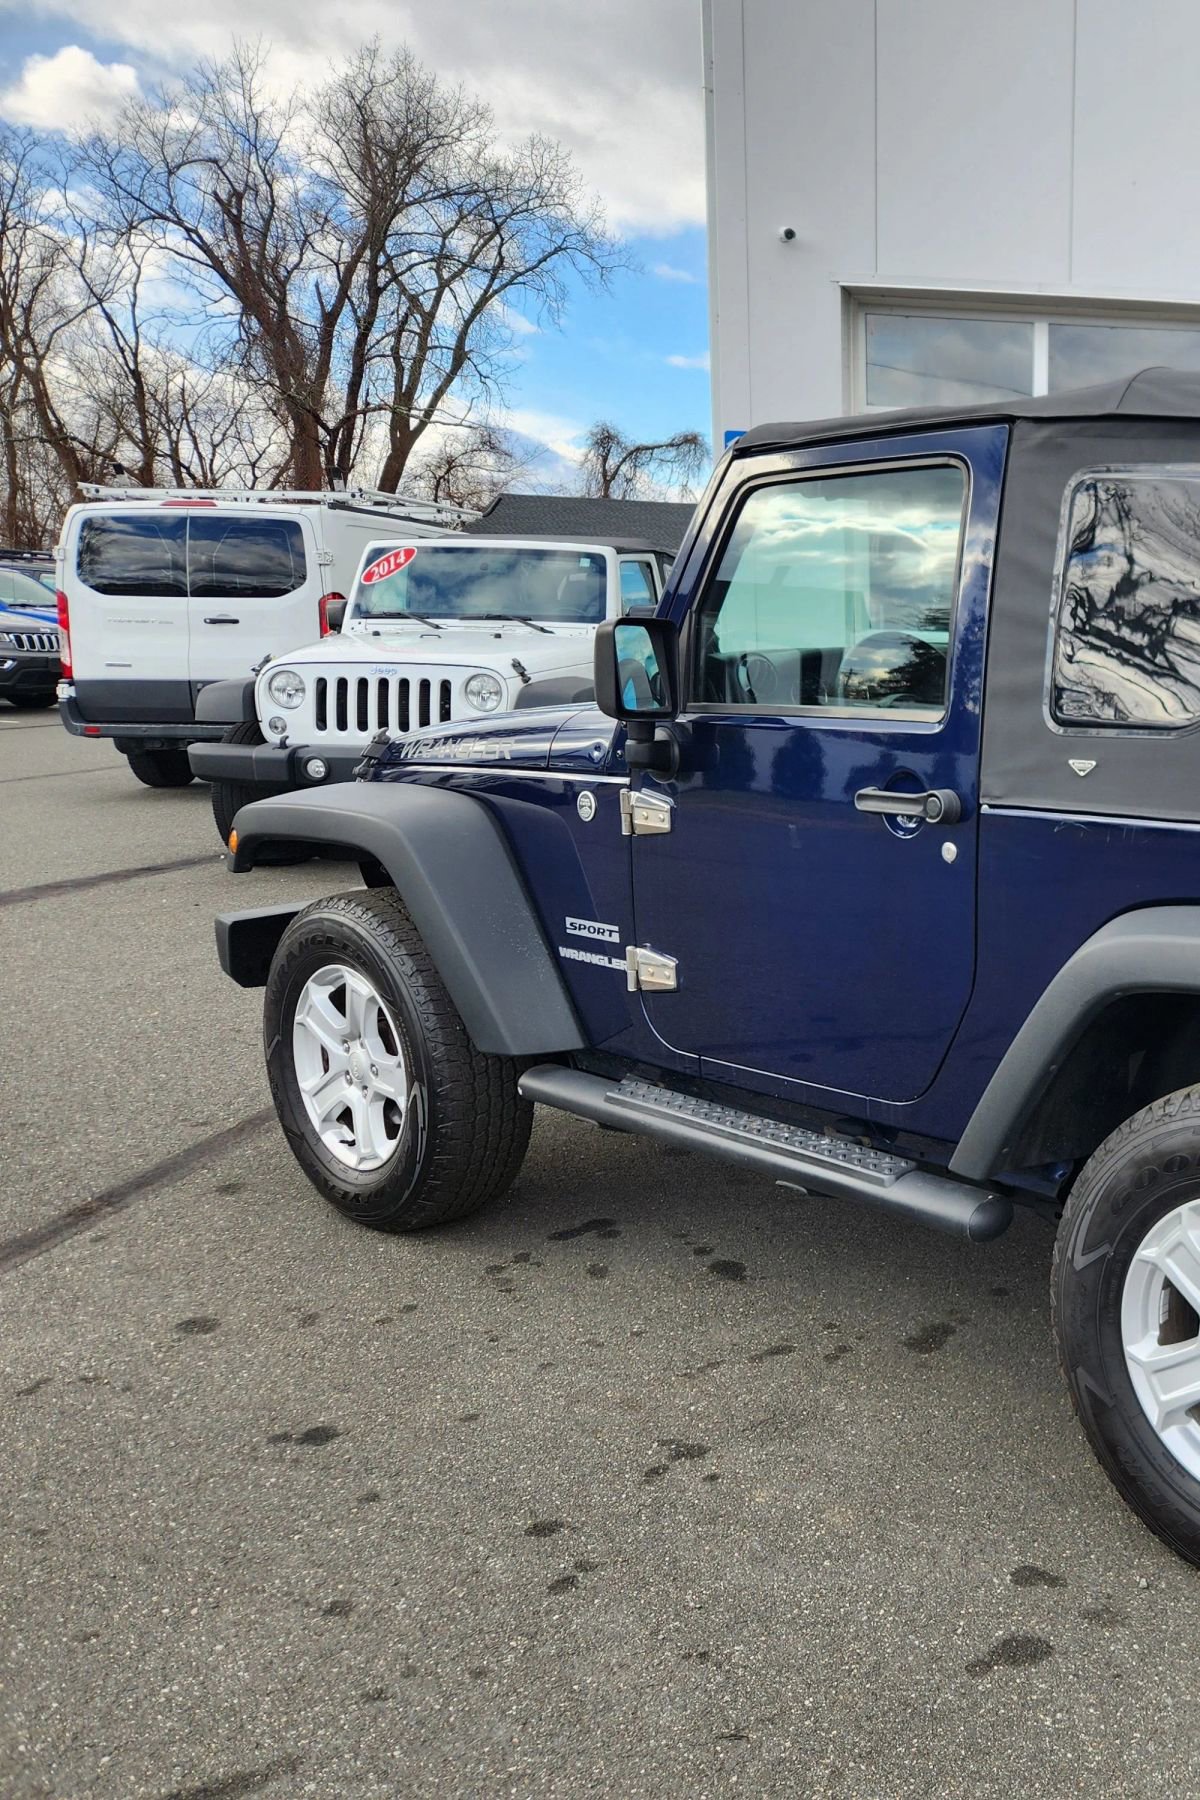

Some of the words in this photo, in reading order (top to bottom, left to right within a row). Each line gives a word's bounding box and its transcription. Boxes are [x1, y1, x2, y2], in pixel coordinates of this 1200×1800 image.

[371, 549, 406, 581] 2014
[401, 737, 515, 760] WRANGLER
[566, 921, 619, 938] SPORT
